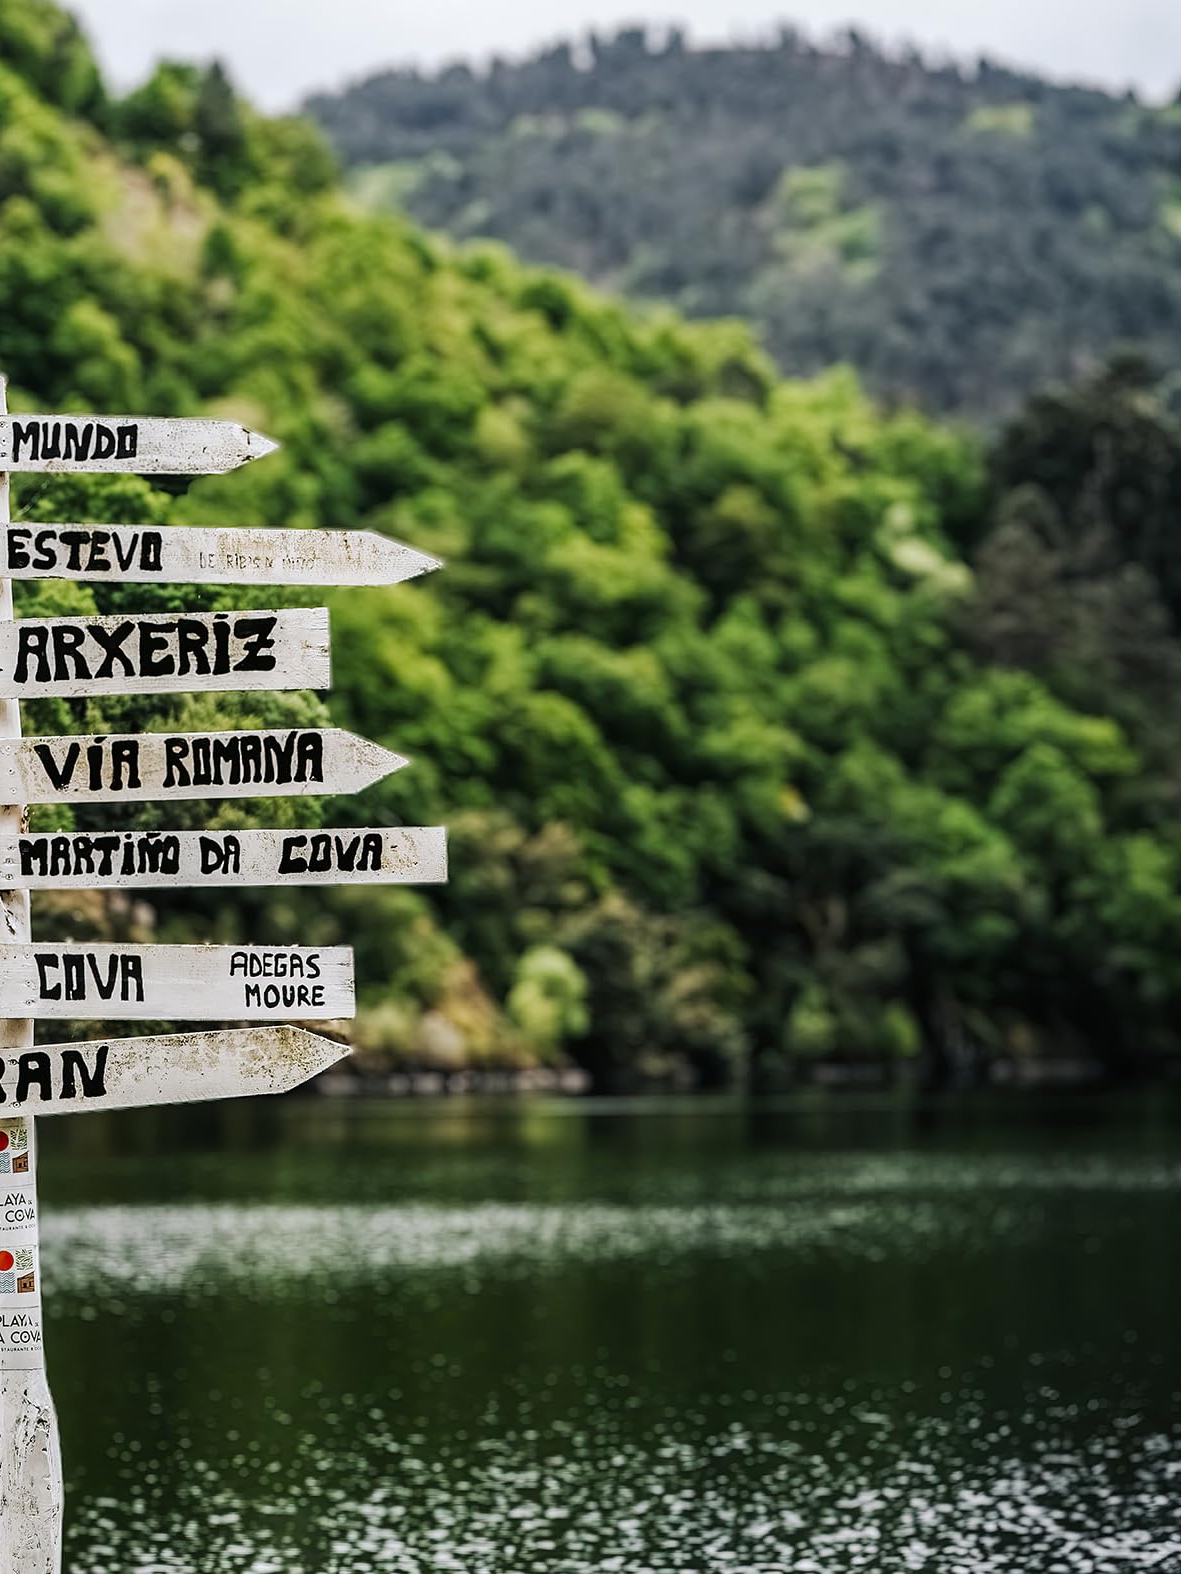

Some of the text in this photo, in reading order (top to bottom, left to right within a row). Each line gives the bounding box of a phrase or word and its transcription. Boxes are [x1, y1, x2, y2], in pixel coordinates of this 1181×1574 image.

[13, 422, 138, 462] MUNDO
[7, 529, 162, 572] ESTEVO
[34, 737, 141, 790] VÍA
[163, 731, 323, 788] ROMANA
[200, 835, 240, 874] DA
[278, 834, 382, 874] COVA
[35, 953, 144, 1001] COVA
[230, 952, 320, 978] ADEGAS
[245, 984, 325, 1008] MOURE
[5, 1208, 35, 1223] COVA
[10, 1331, 41, 1344] COVA
